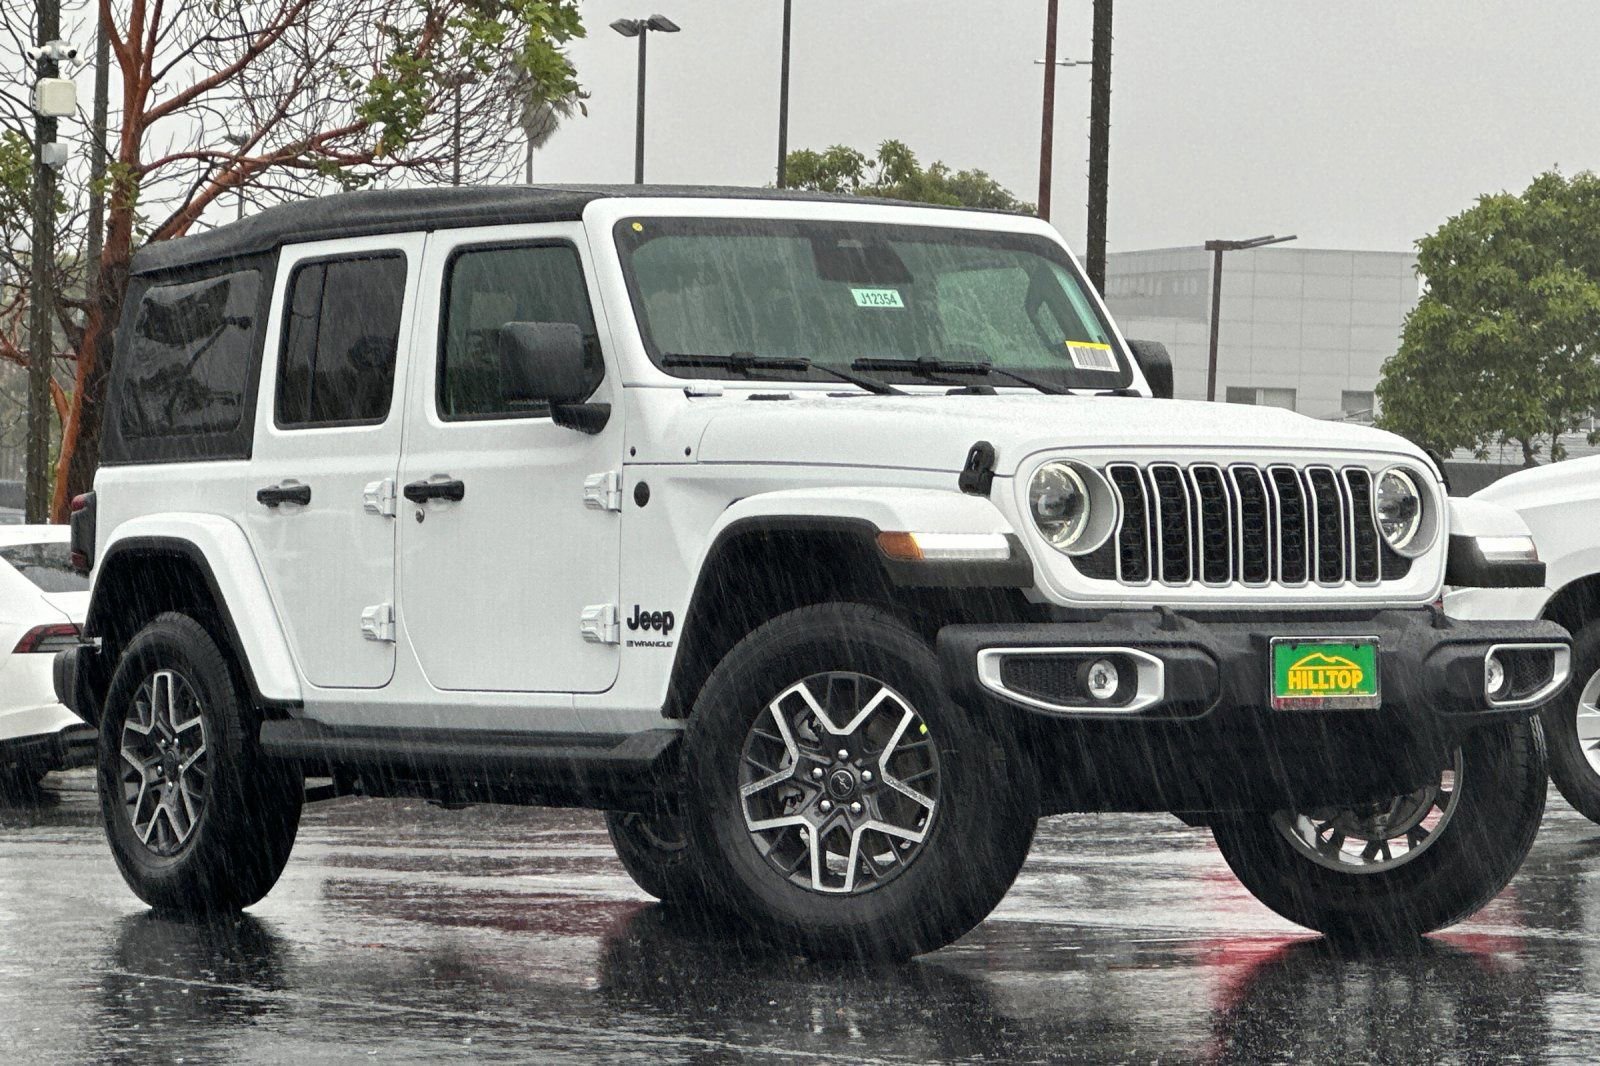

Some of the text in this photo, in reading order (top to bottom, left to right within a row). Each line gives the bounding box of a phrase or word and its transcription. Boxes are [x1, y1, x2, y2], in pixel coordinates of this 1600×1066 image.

[860, 292, 898, 305] J12354
[627, 604, 675, 636] Jeep
[1288, 669, 1364, 690] HILLTOP
